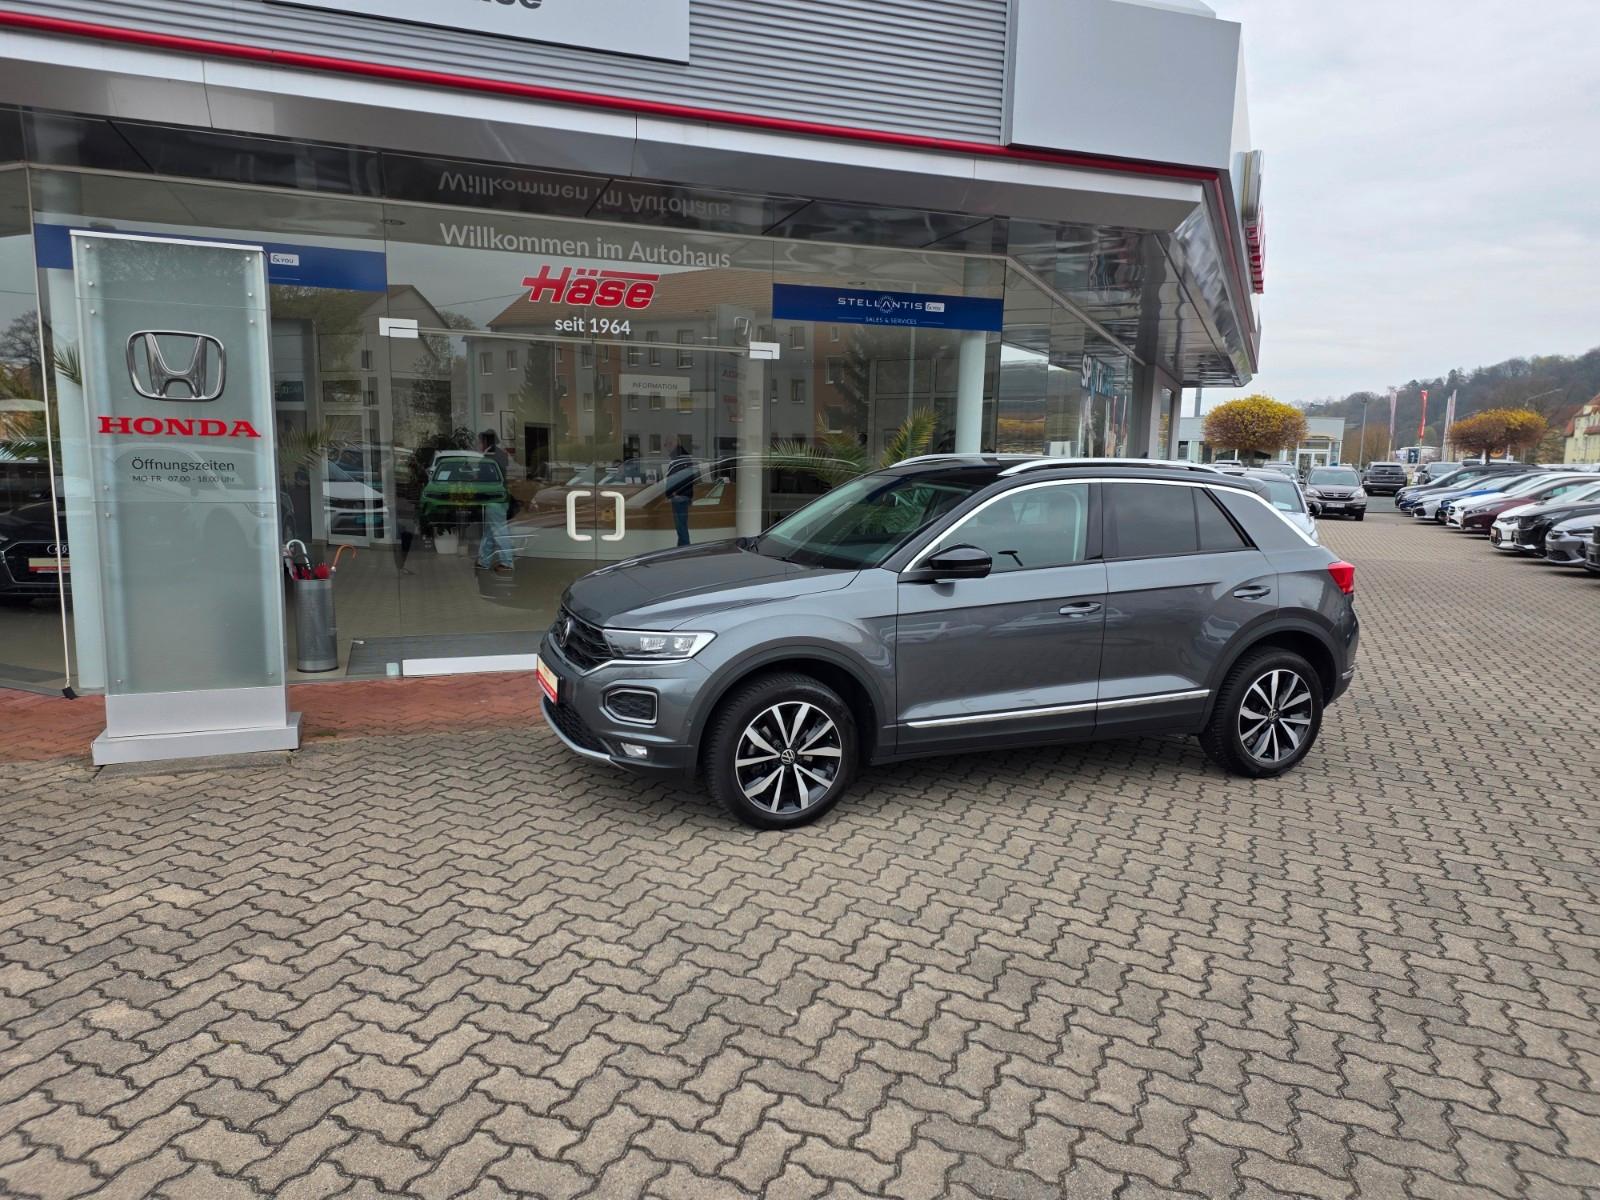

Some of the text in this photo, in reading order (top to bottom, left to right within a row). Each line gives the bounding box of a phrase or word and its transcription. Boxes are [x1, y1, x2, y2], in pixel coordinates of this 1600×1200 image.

[439, 222, 731, 268] Willkommen im Autohaus
[521, 264, 660, 310] Häse
[837, 297, 923, 310] STELLANTIS
[554, 316, 632, 335] seit 1964
[632, 382, 678, 390] INFORMATION
[98, 416, 262, 438] HONDA
[131, 457, 235, 473] Öffnungszeiten
